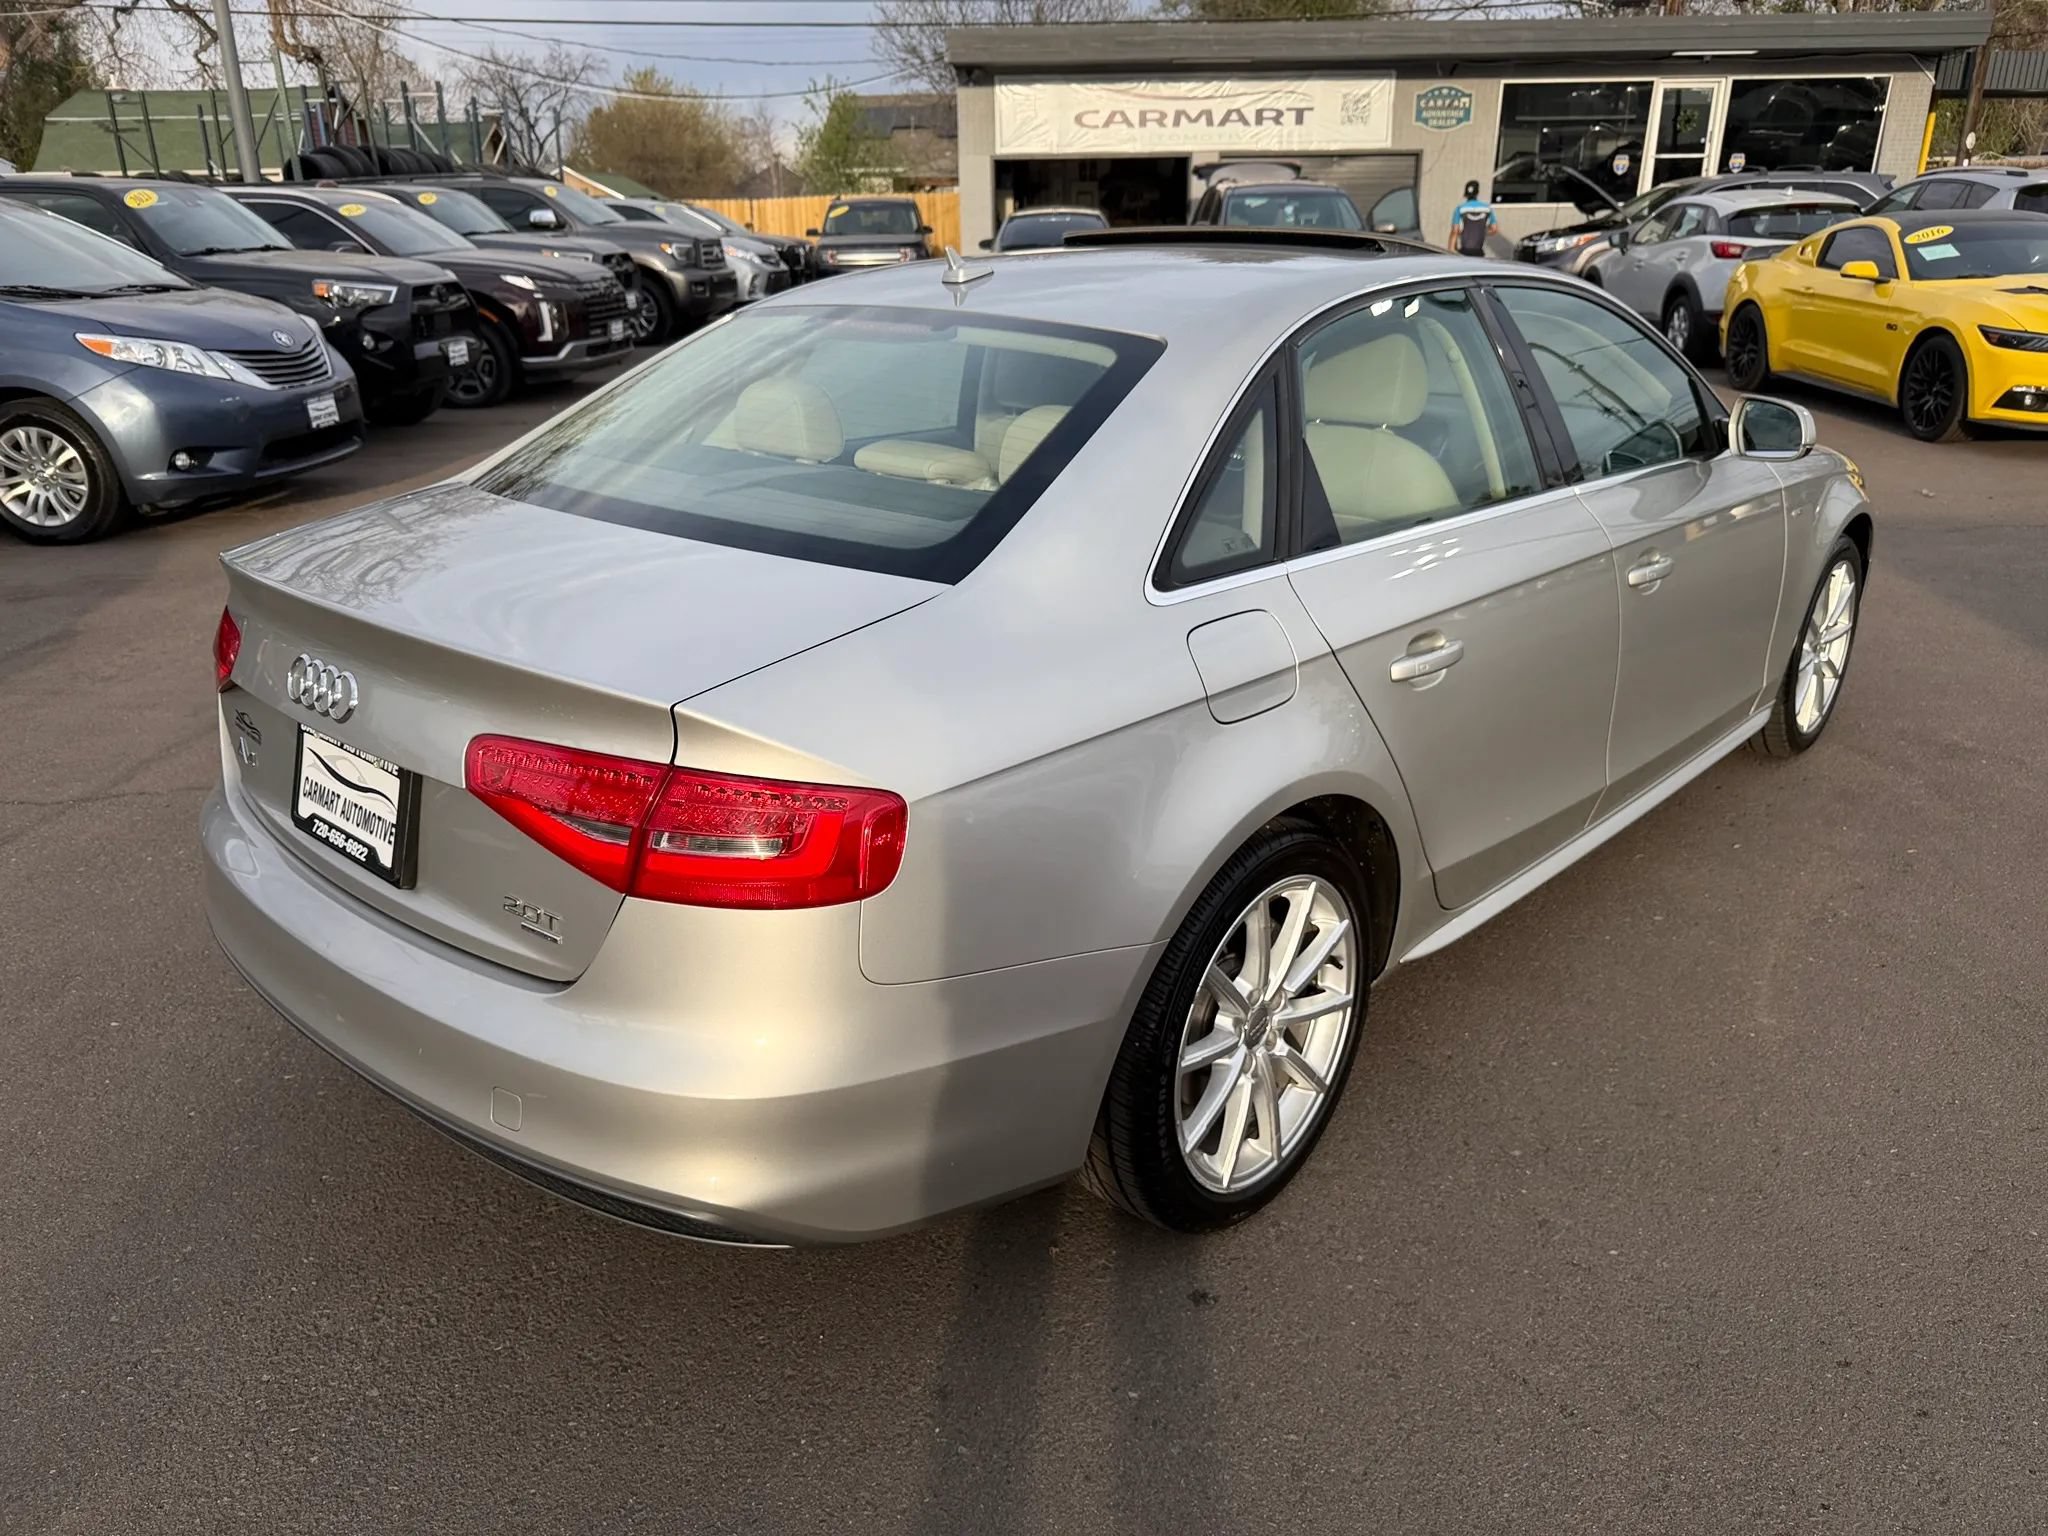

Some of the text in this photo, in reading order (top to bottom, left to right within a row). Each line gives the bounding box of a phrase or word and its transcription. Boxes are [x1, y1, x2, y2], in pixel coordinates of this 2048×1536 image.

[1074, 106, 1314, 129] CARMART
[1916, 227, 1945, 242] 2016
[302, 776, 396, 846] CARMART AUTOMOTIVE
[312, 819, 369, 862] 720-656-6922
